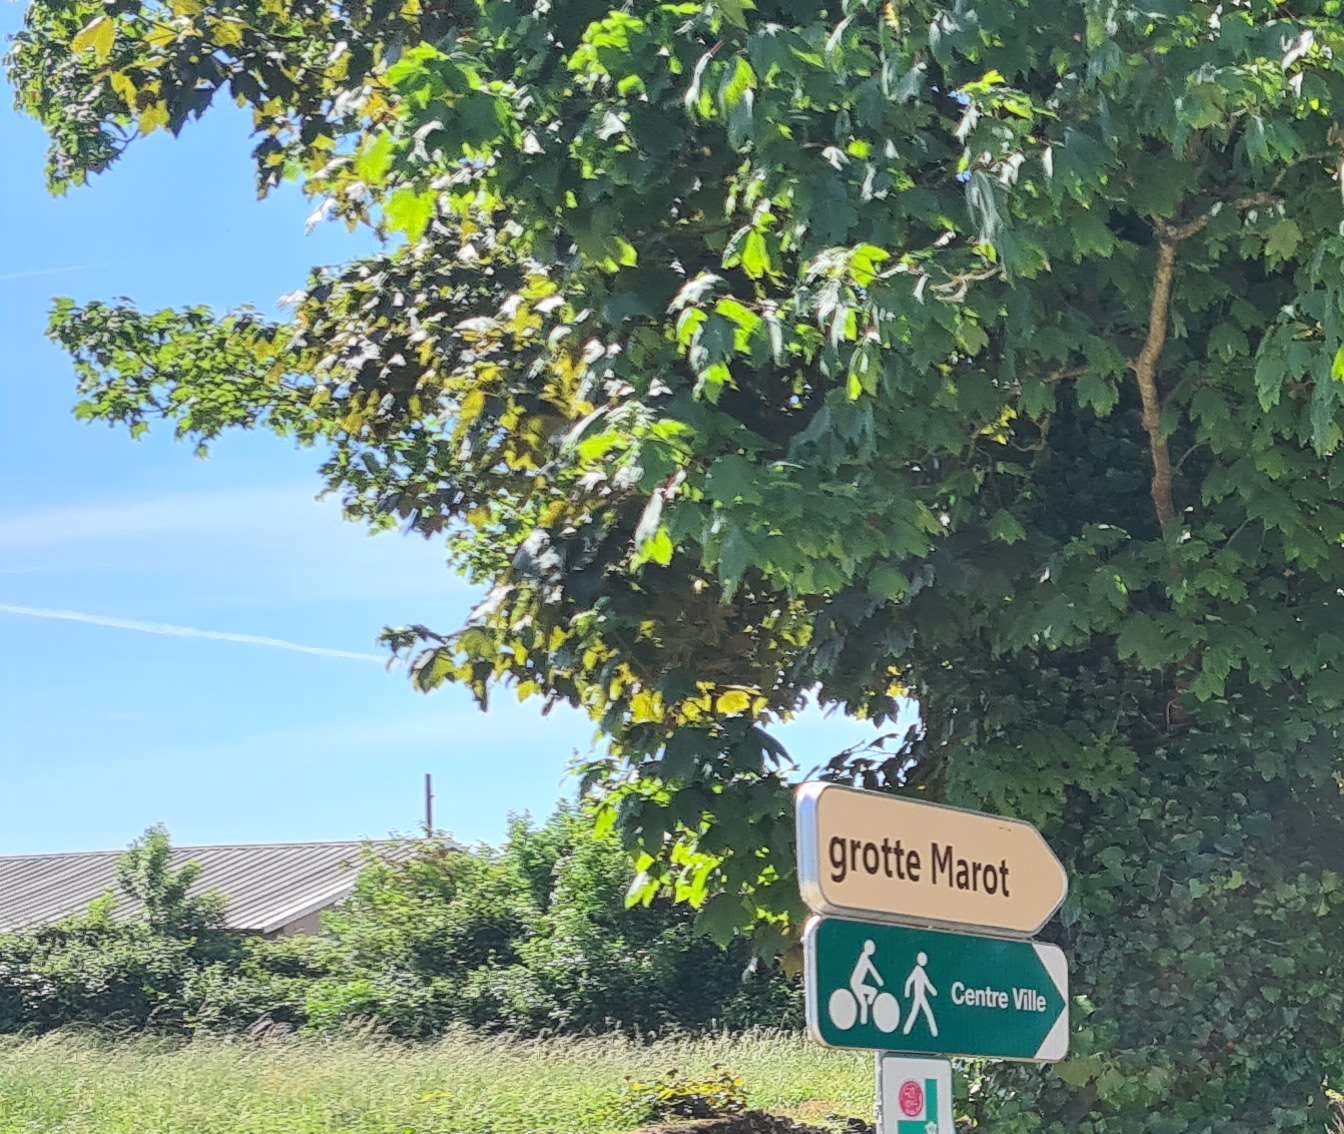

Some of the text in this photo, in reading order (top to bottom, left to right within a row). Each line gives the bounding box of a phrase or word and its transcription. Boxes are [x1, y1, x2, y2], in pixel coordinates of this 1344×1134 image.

[829, 836, 1009, 897] grotte Marot
[951, 981, 1046, 1012] Centre Ville
